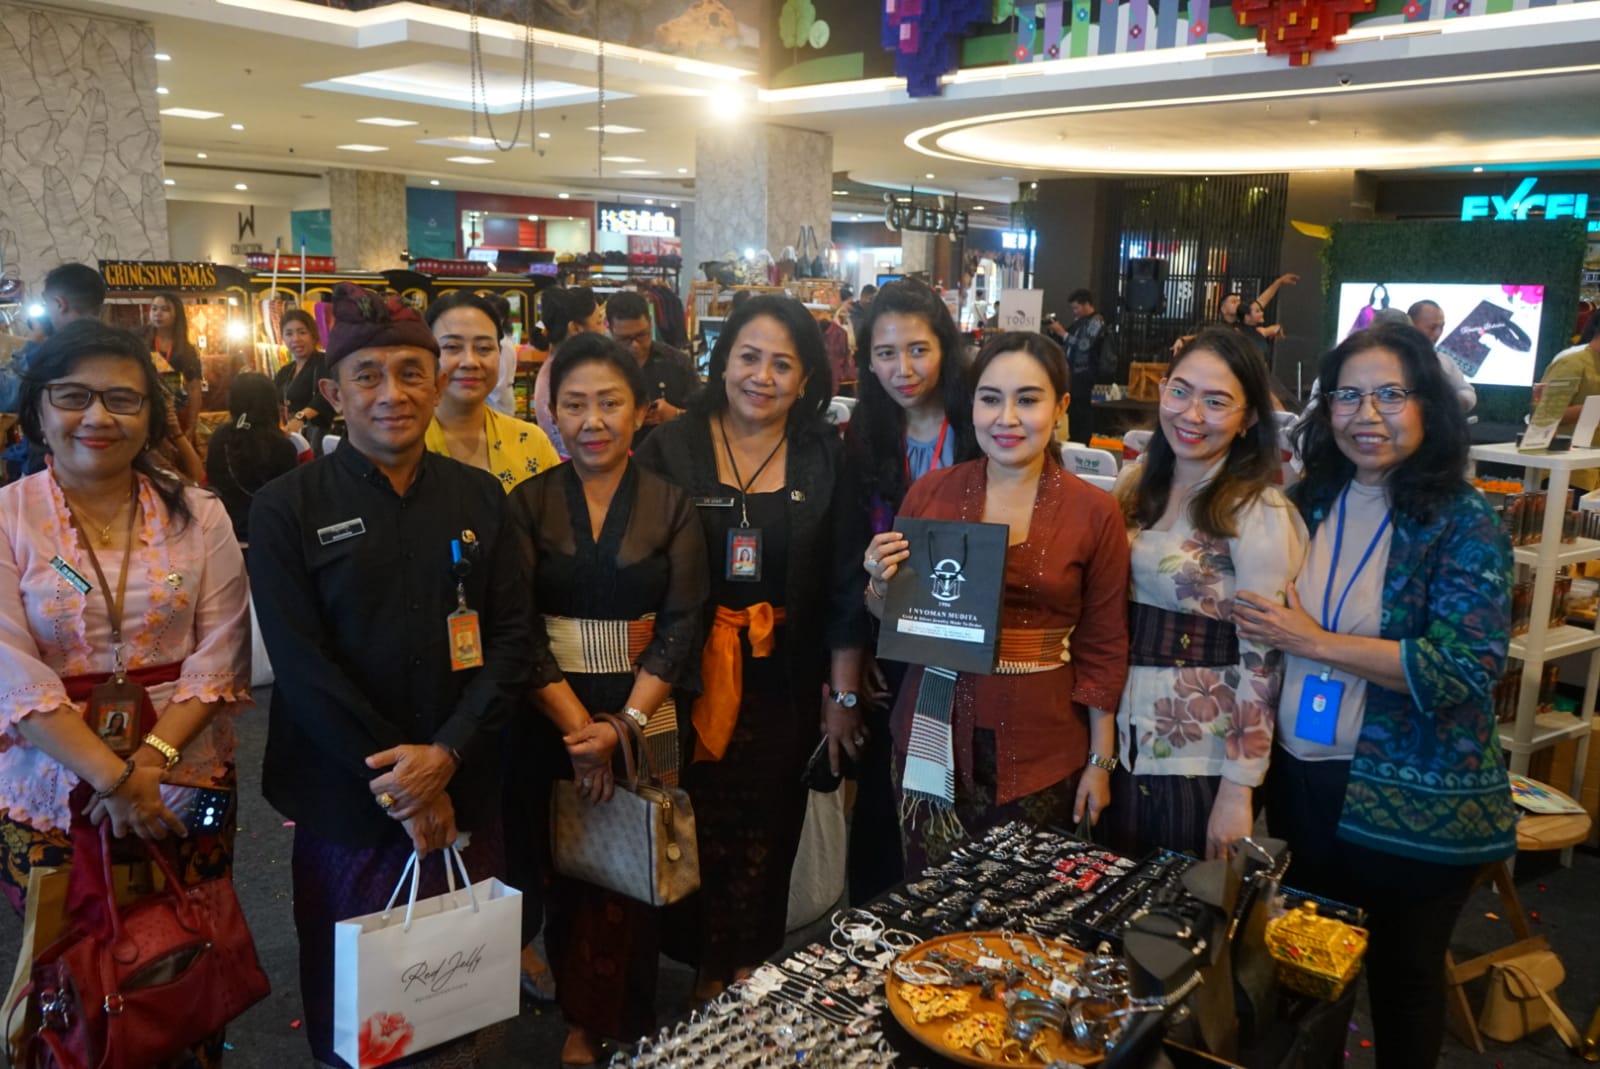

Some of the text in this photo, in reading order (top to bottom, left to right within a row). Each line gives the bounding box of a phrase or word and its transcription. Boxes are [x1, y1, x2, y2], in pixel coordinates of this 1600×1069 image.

[179, 263, 217, 286] EMAS
[913, 608, 946, 618] NYOMAN
[948, 612, 978, 621] MUDITA
